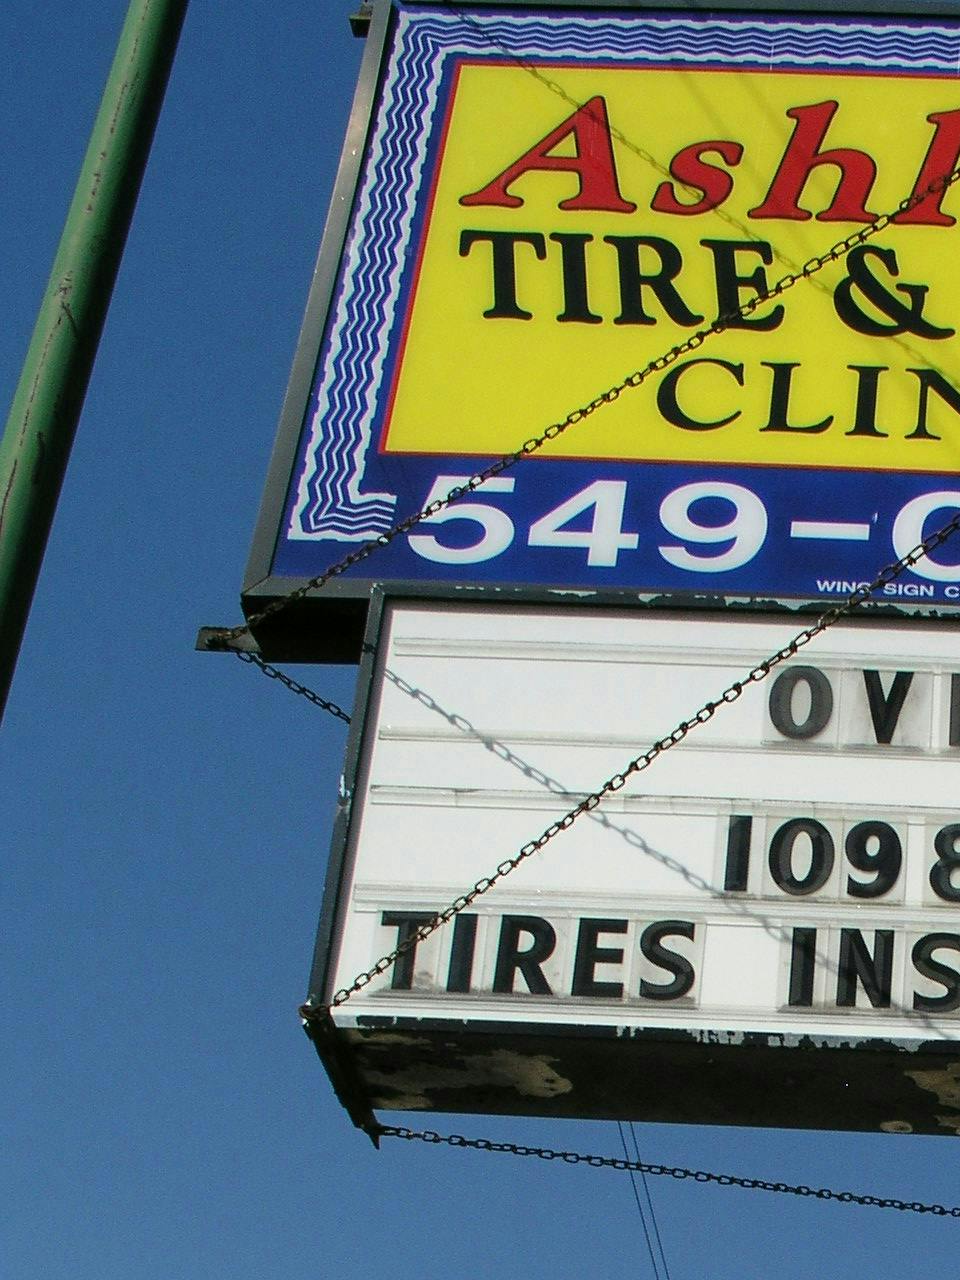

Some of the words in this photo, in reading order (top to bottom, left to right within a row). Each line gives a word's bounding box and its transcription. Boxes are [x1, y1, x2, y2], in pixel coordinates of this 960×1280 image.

[458, 229, 785, 331] TIRE
[833, 244, 955, 340] &
[883, 583, 935, 597] SIGN
[380, 910, 696, 1001] TIRES
